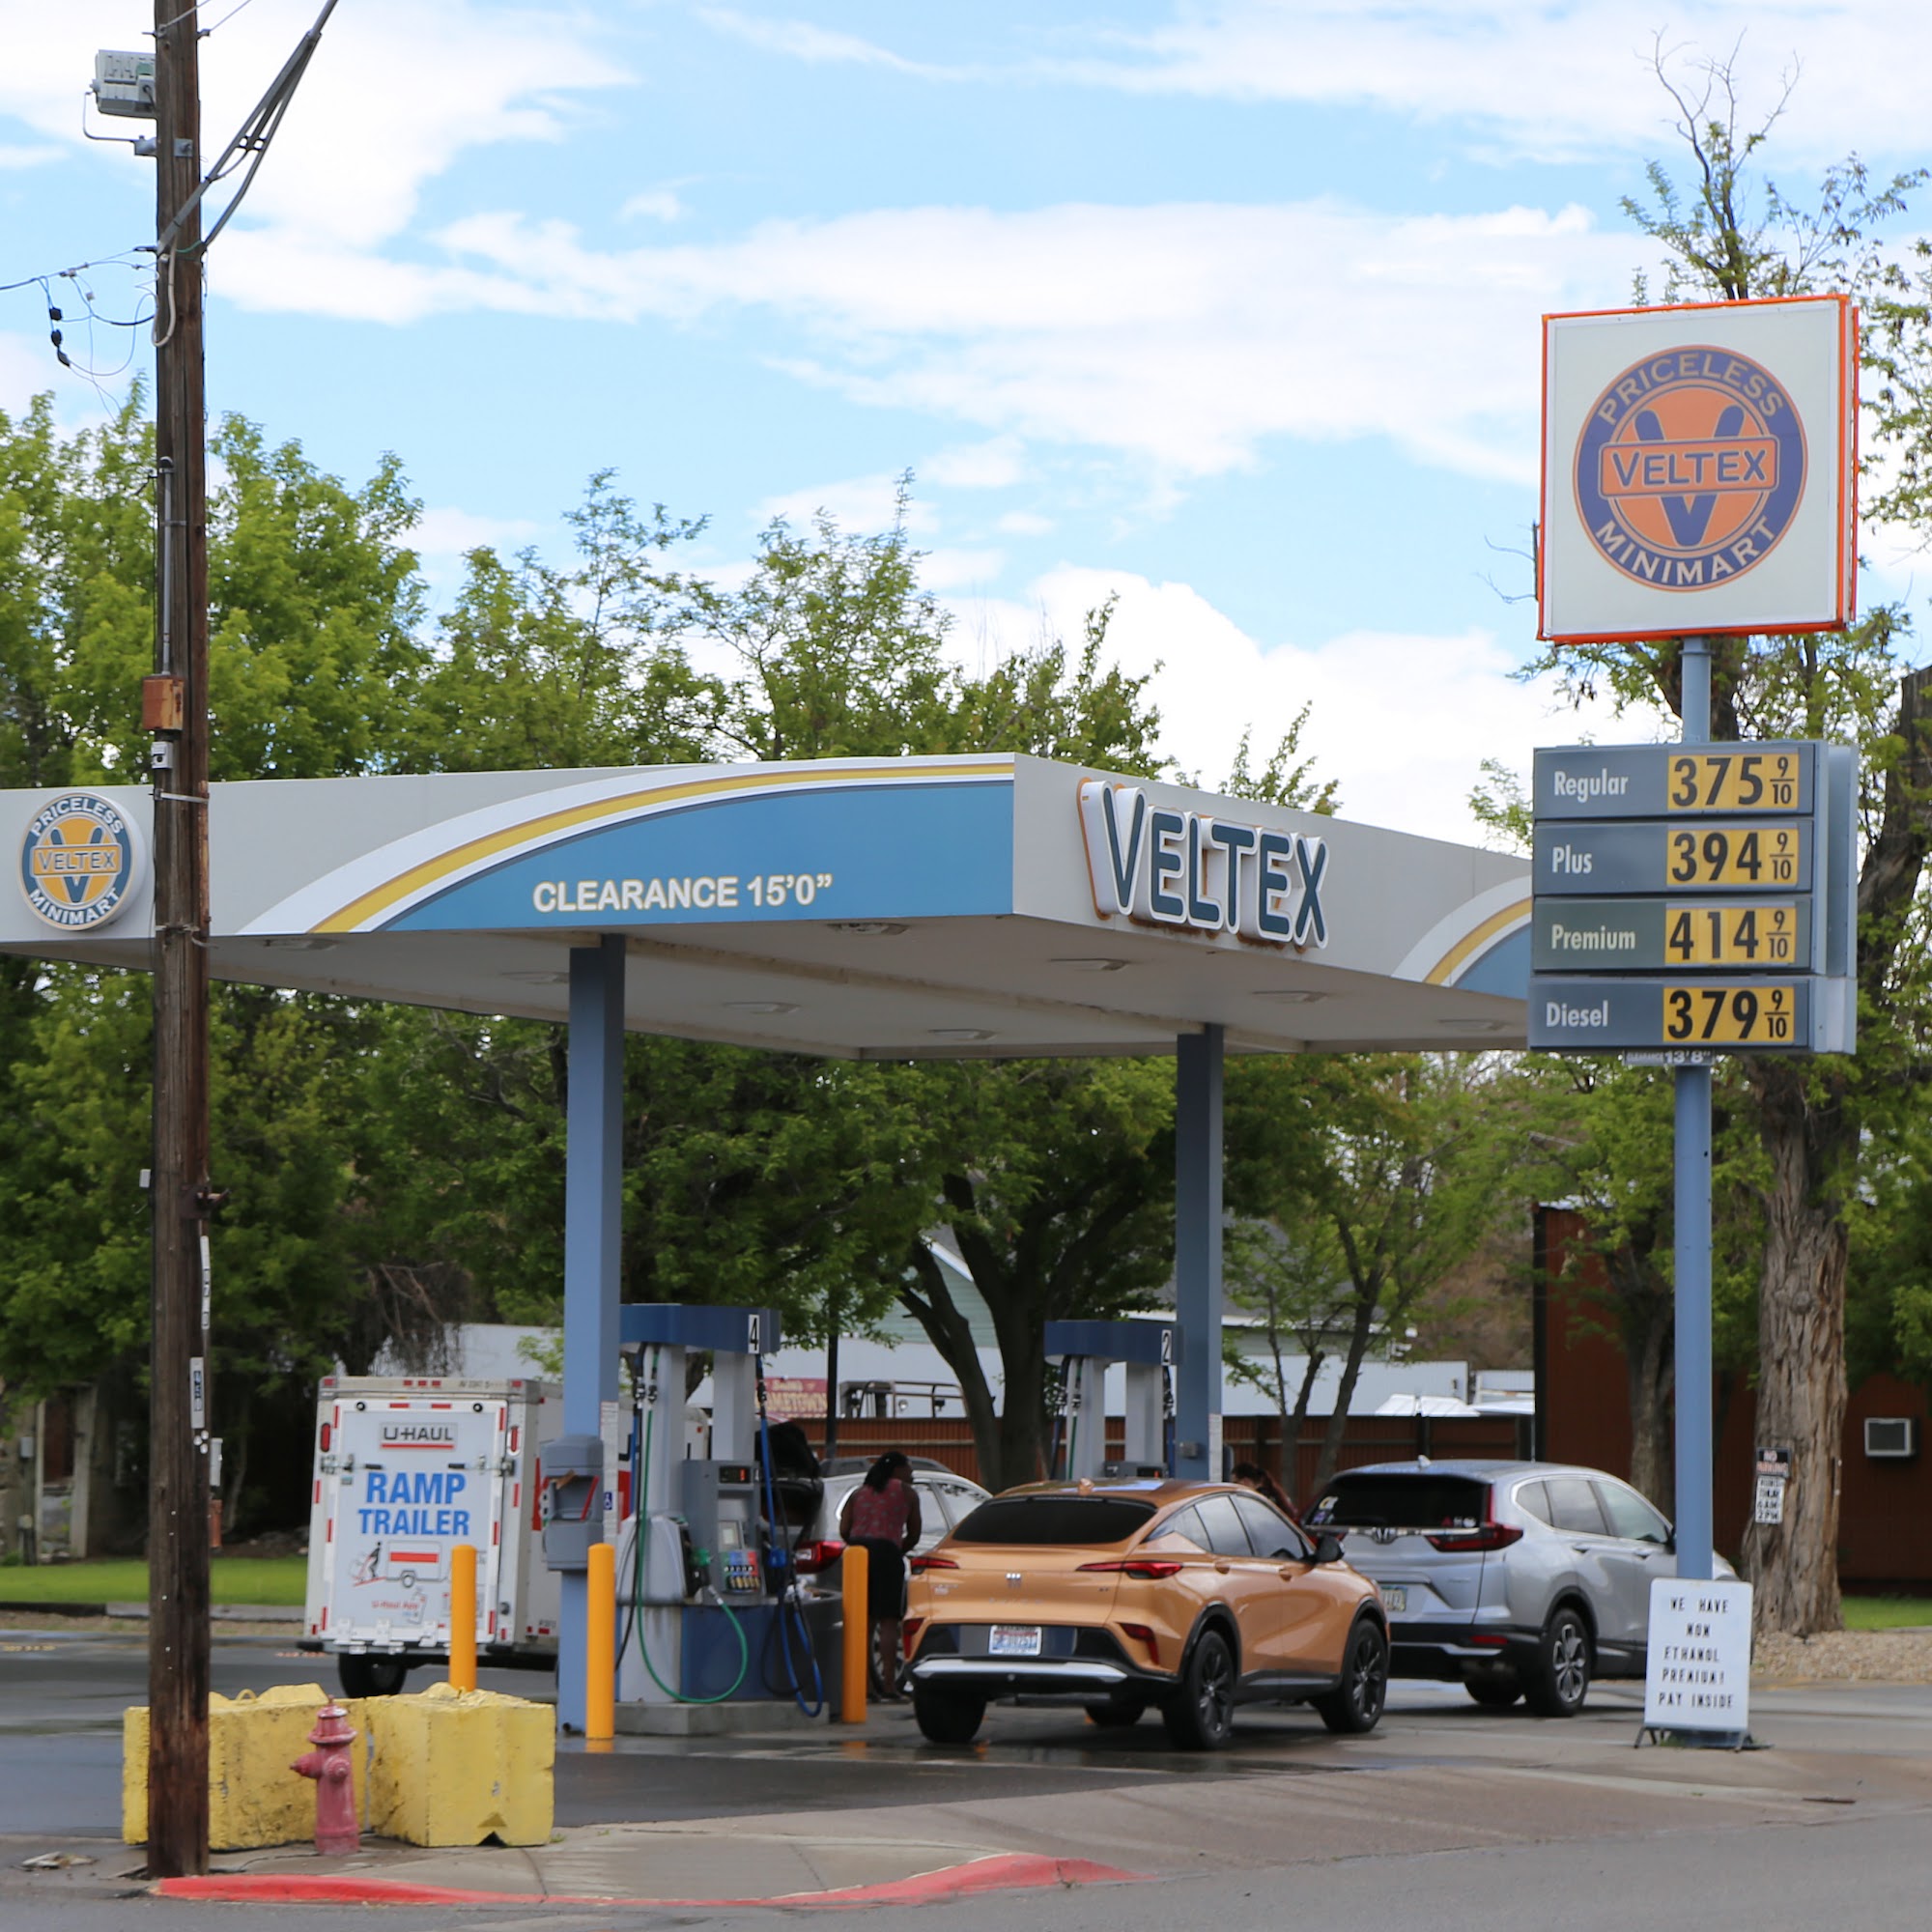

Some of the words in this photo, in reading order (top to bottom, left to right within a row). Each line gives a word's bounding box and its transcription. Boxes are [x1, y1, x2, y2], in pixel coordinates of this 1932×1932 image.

[1597, 353, 1784, 426] PRICELESS
[1611, 448, 1767, 488] VELTEX
[1595, 516, 1776, 585] MINIMART
[1553, 769, 1629, 803] Regular
[1671, 756, 1764, 807] 375
[30, 797, 125, 838] PRICELESS
[38, 851, 116, 870] VELTEX
[1080, 778, 1329, 951] VELTEX
[1551, 845, 1593, 873] Plus
[1671, 832, 1762, 882] 394
[29, 887, 120, 924] MINIMART
[532, 876, 739, 913] CLEARANCE
[1551, 924, 1636, 950] Premium
[1669, 910, 1759, 960] 414
[1546, 1000, 1609, 1027] Diesel
[1667, 989, 1758, 1039] 379
[749, 1317, 758, 1351] 4
[1162, 1332, 1171, 1362] 2
[383, 1426, 454, 1441] U-HAUL
[365, 1471, 467, 1504] RAMP
[356, 1508, 470, 1536] TRAILER
[1670, 1597, 1686, 1611] WE
[1698, 1599, 1729, 1613] HAVE
[1663, 1646, 1719, 1662] ETHANOL
[1658, 1692, 1682, 1707] PAY
[1691, 1693, 1734, 1709] INSIDE
